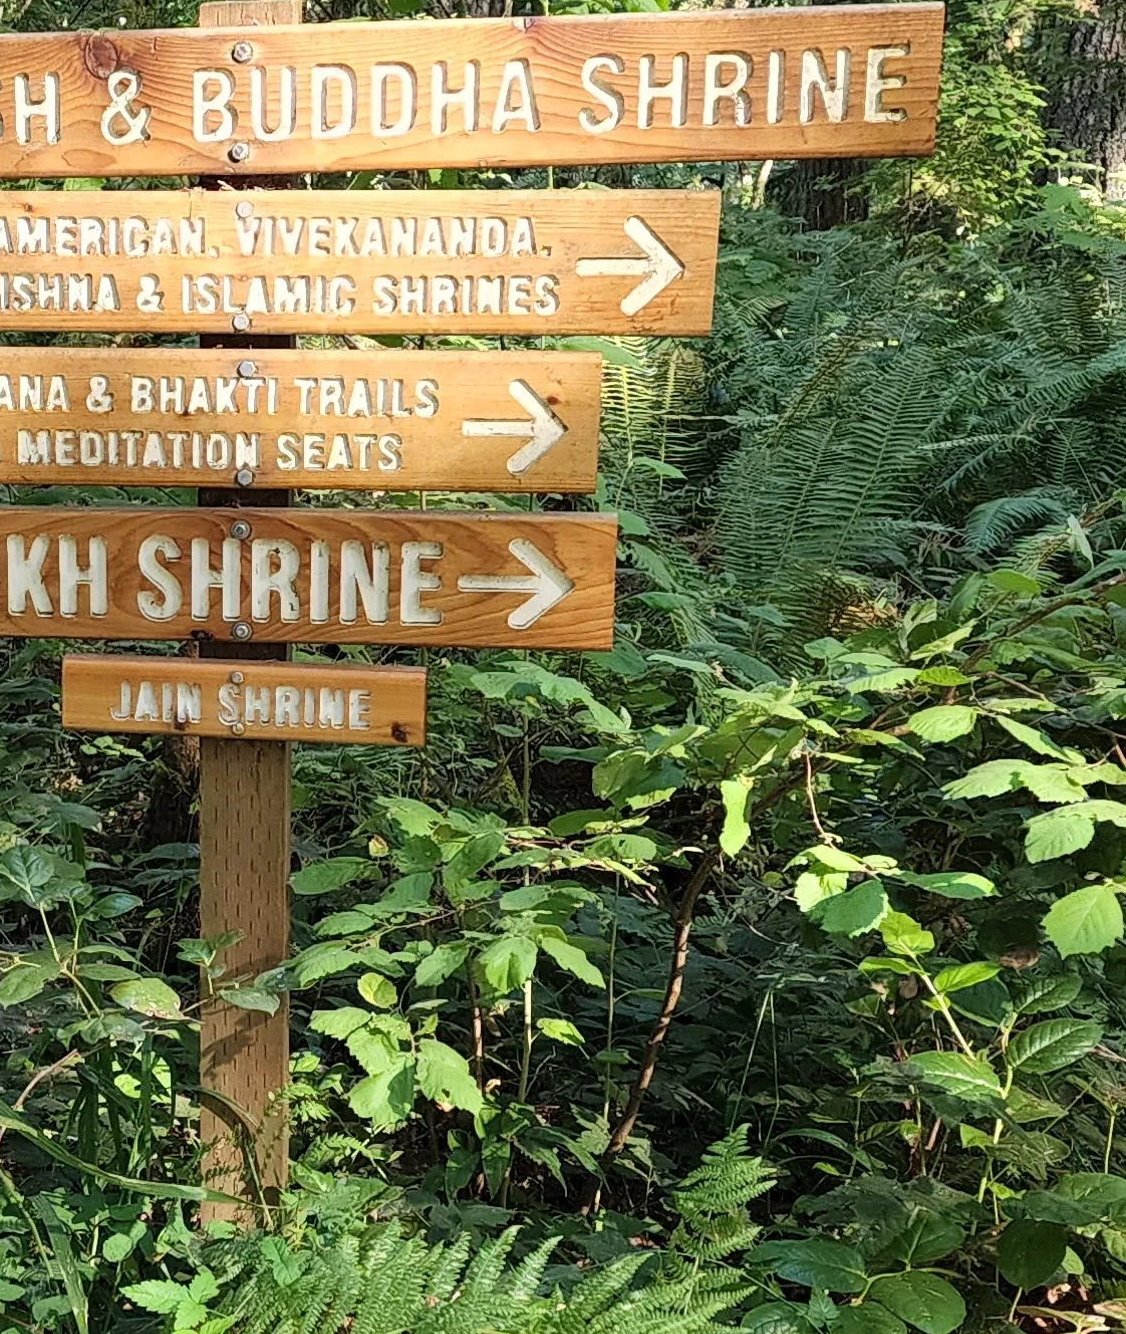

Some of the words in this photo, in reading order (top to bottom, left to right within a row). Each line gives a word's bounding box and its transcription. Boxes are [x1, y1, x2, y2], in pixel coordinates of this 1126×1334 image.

[99, 68, 152, 147] &
[192, 58, 541, 143] BUDDHA
[579, 42, 911, 133] SHRINE
[136, 272, 165, 314] &
[180, 274, 358, 317] ISLAMIC
[372, 273, 559, 317] SHRINES
[85, 374, 115, 414] &
[129, 374, 280, 416] BHAKTI
[292, 377, 441, 419] TRAILS
[17, 428, 262, 470] MEDITATION
[275, 432, 404, 472] SEATS
[136, 535, 445, 628] SHRINE
[110, 680, 203, 725] JAIN
[216, 681, 373, 732] SHRINE
